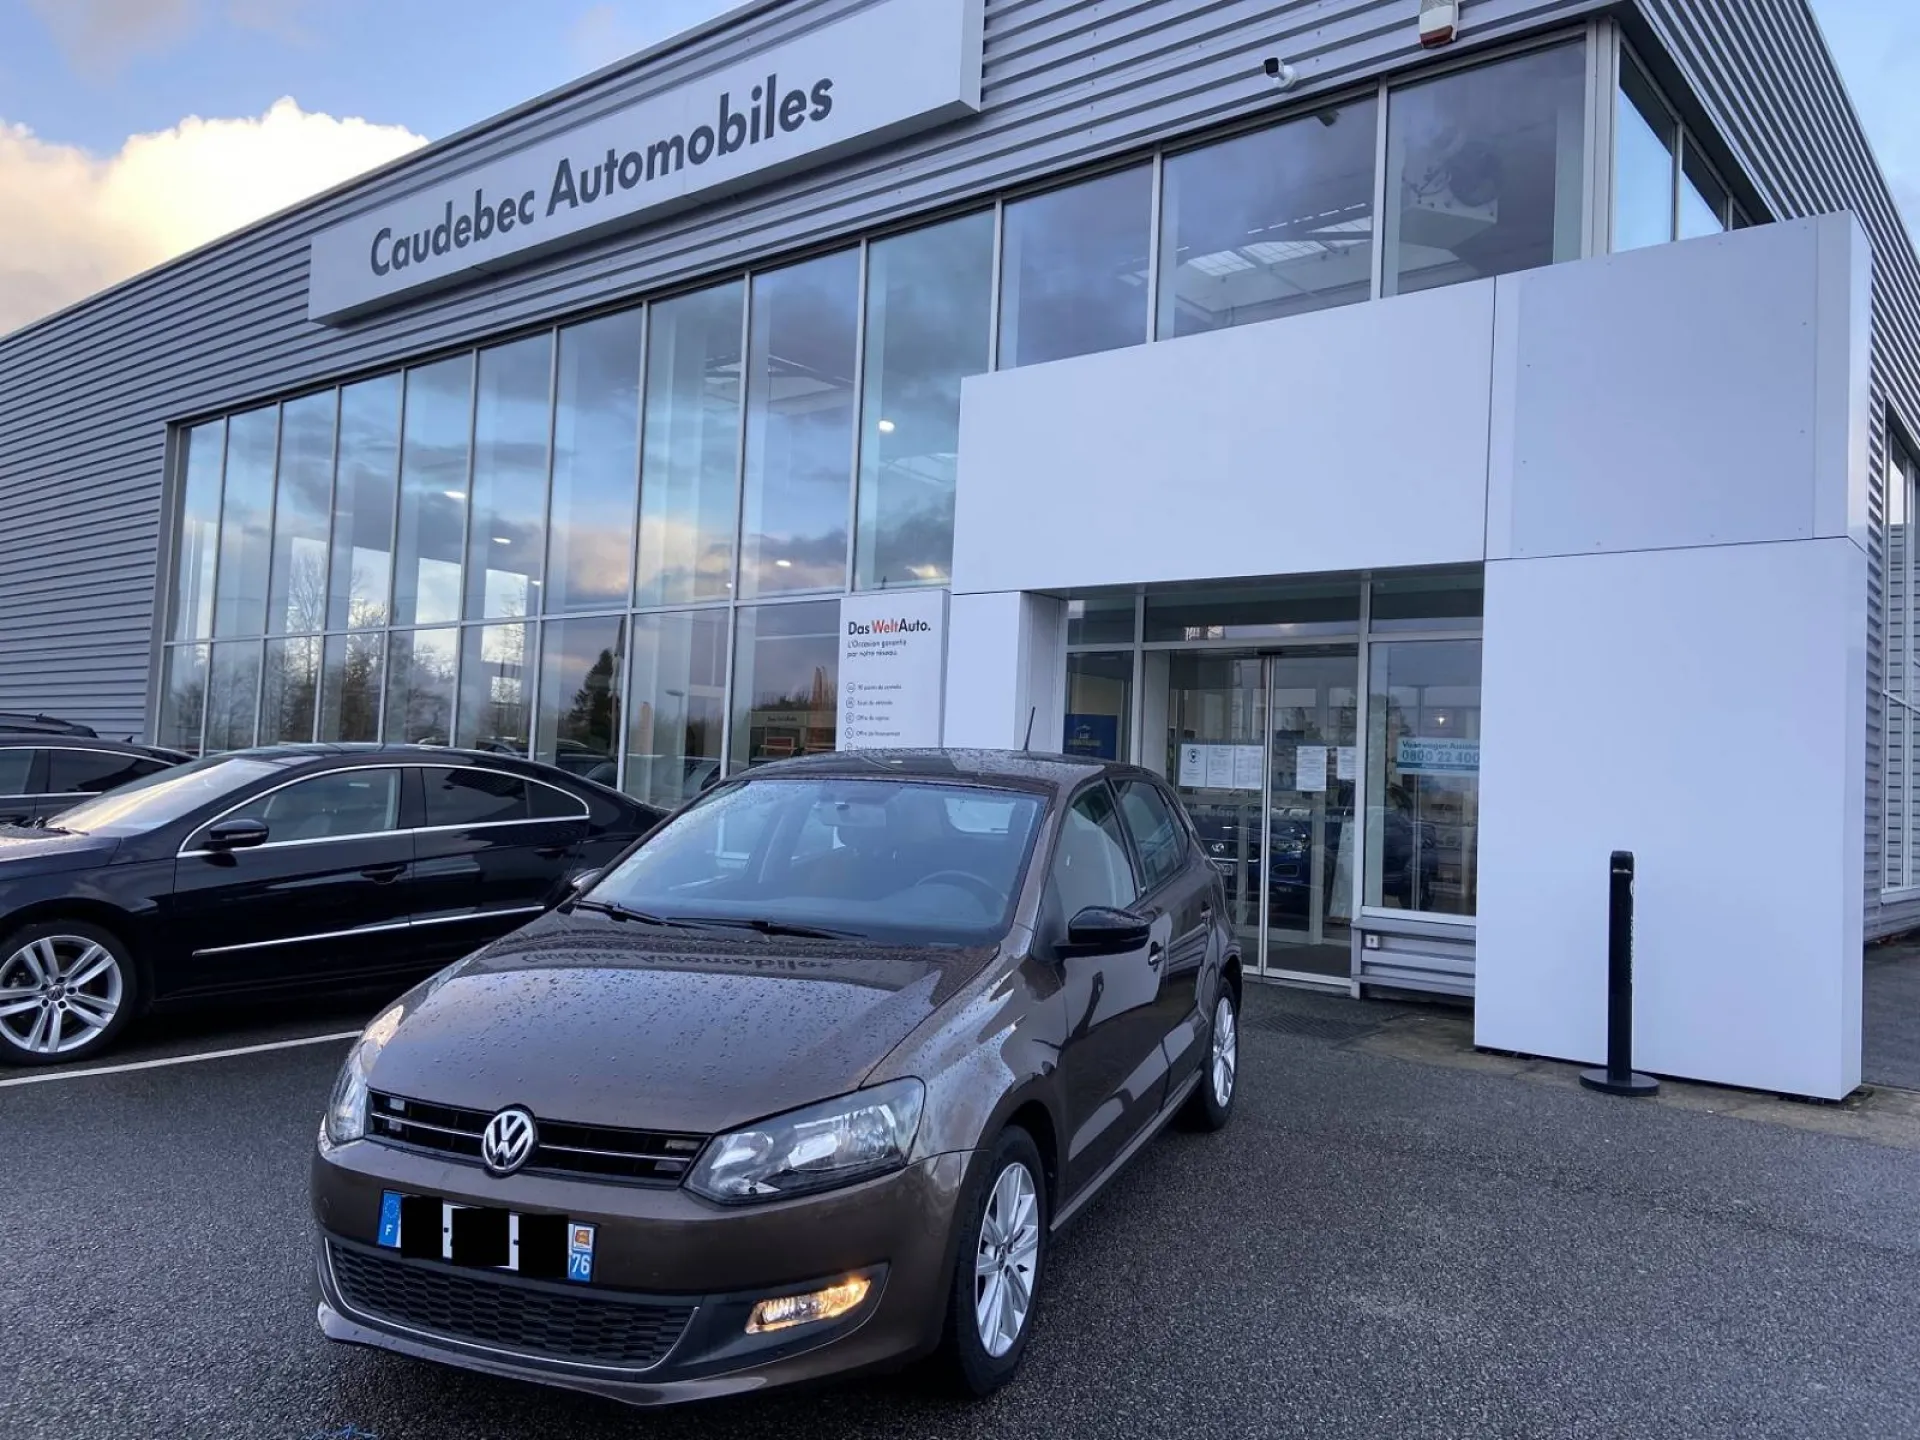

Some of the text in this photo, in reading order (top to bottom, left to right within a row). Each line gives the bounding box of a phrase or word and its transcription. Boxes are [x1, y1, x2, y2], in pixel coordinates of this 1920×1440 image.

[370, 73, 834, 277] Caudebec Automobiles
[847, 617, 931, 635] Das WeltAuto.
[1402, 750, 1433, 761] 0800
[384, 1224, 393, 1236] F
[571, 1253, 591, 1274] 76
